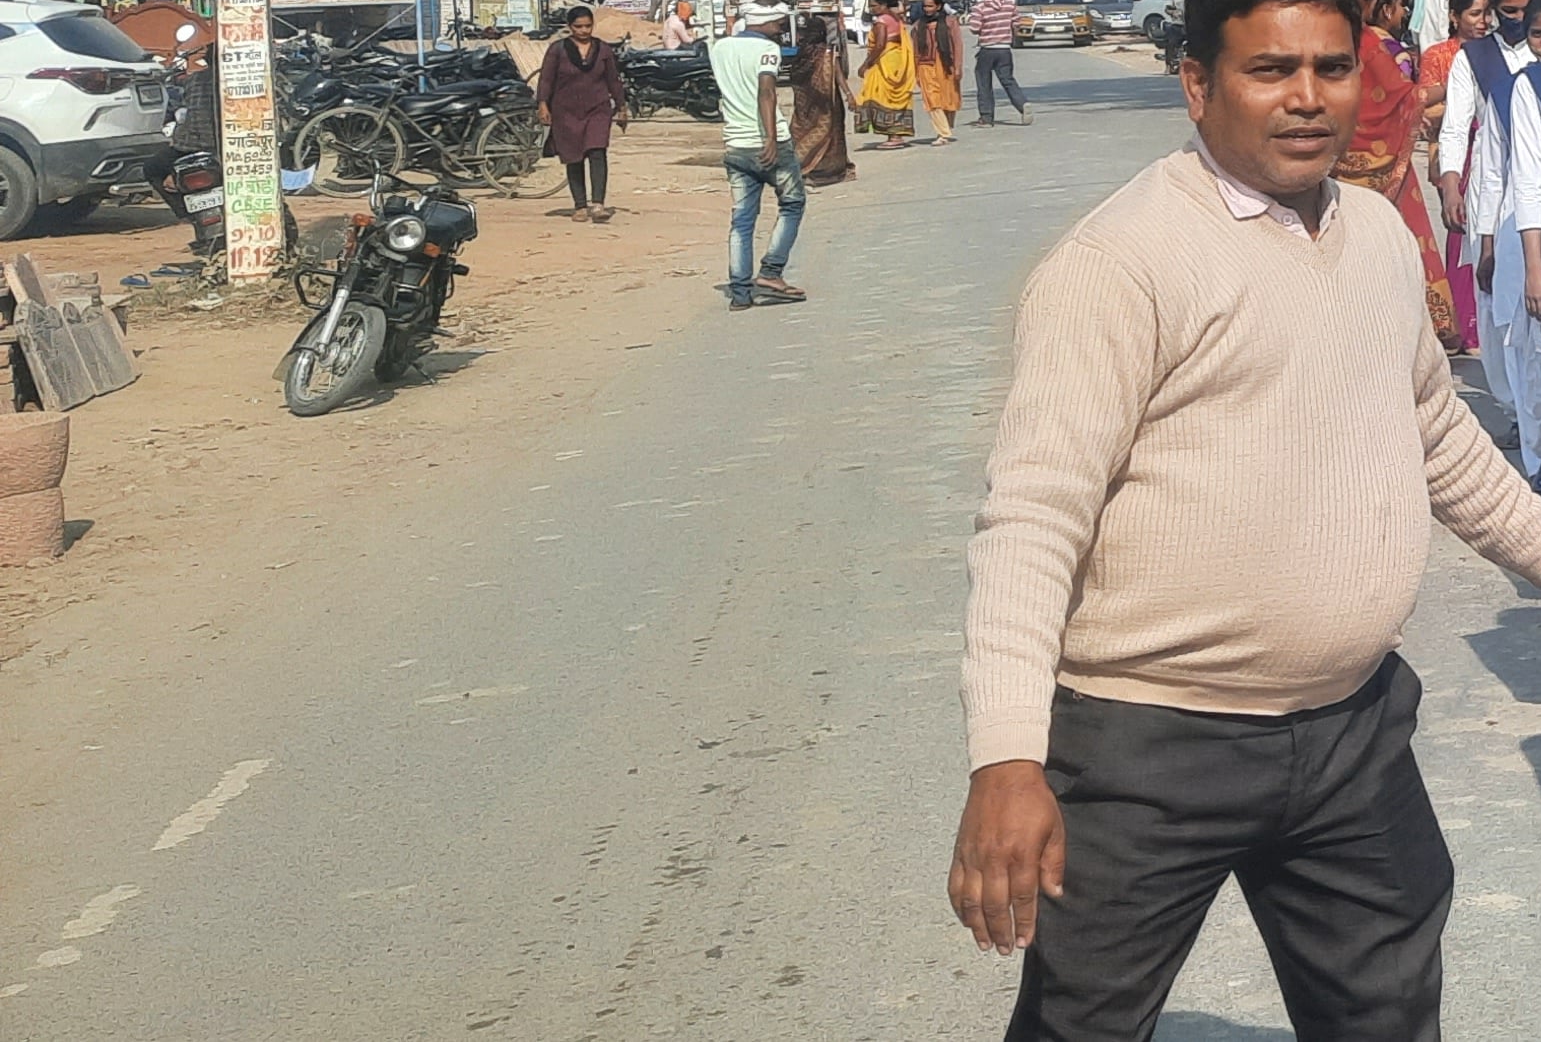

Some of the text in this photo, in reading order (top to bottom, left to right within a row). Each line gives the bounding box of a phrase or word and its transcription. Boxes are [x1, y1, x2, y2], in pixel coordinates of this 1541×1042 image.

[761, 54, 778, 65] 03
[227, 181, 244, 196] UP
[232, 198, 273, 214] CBSE
